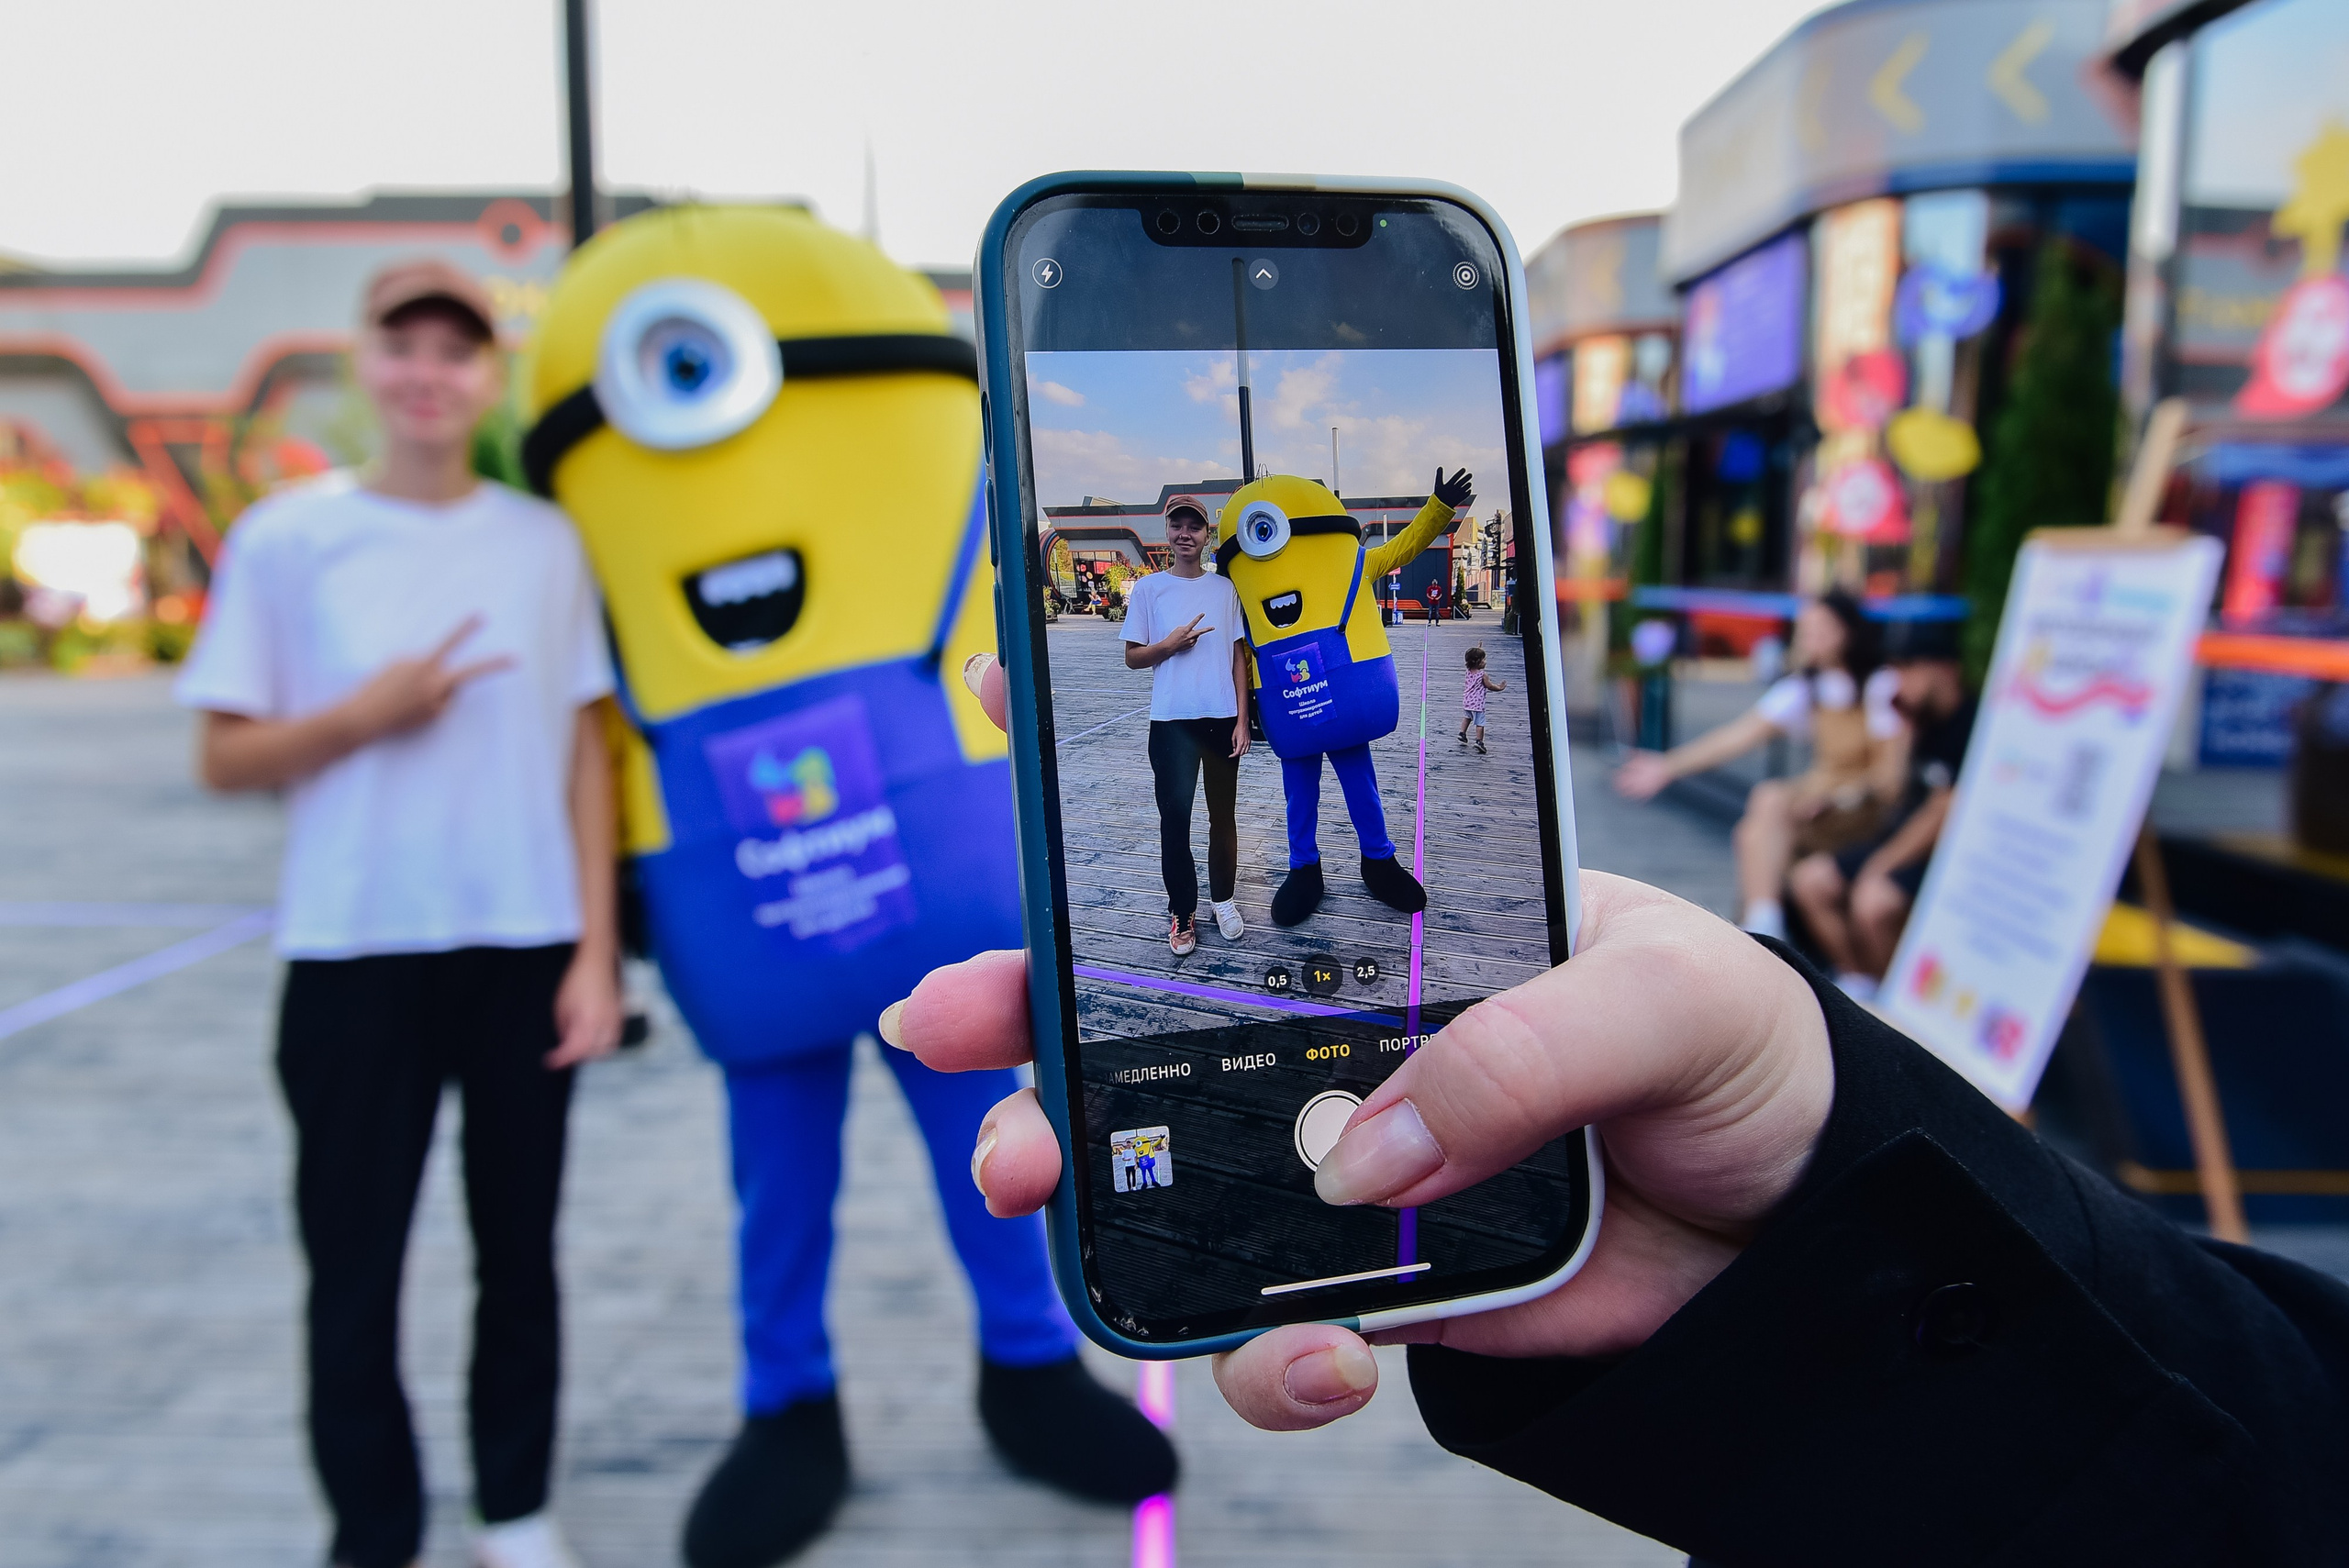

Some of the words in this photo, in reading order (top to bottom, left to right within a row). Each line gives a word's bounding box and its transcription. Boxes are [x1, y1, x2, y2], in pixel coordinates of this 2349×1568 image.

[1283, 680, 1328, 698] Софтиум
[1267, 974, 1287, 988] 0,5
[1356, 965, 1375, 979] 2,5
[1221, 1052, 1276, 1072] ВИДЕО
[1306, 1044, 1351, 1061] ФОТО
